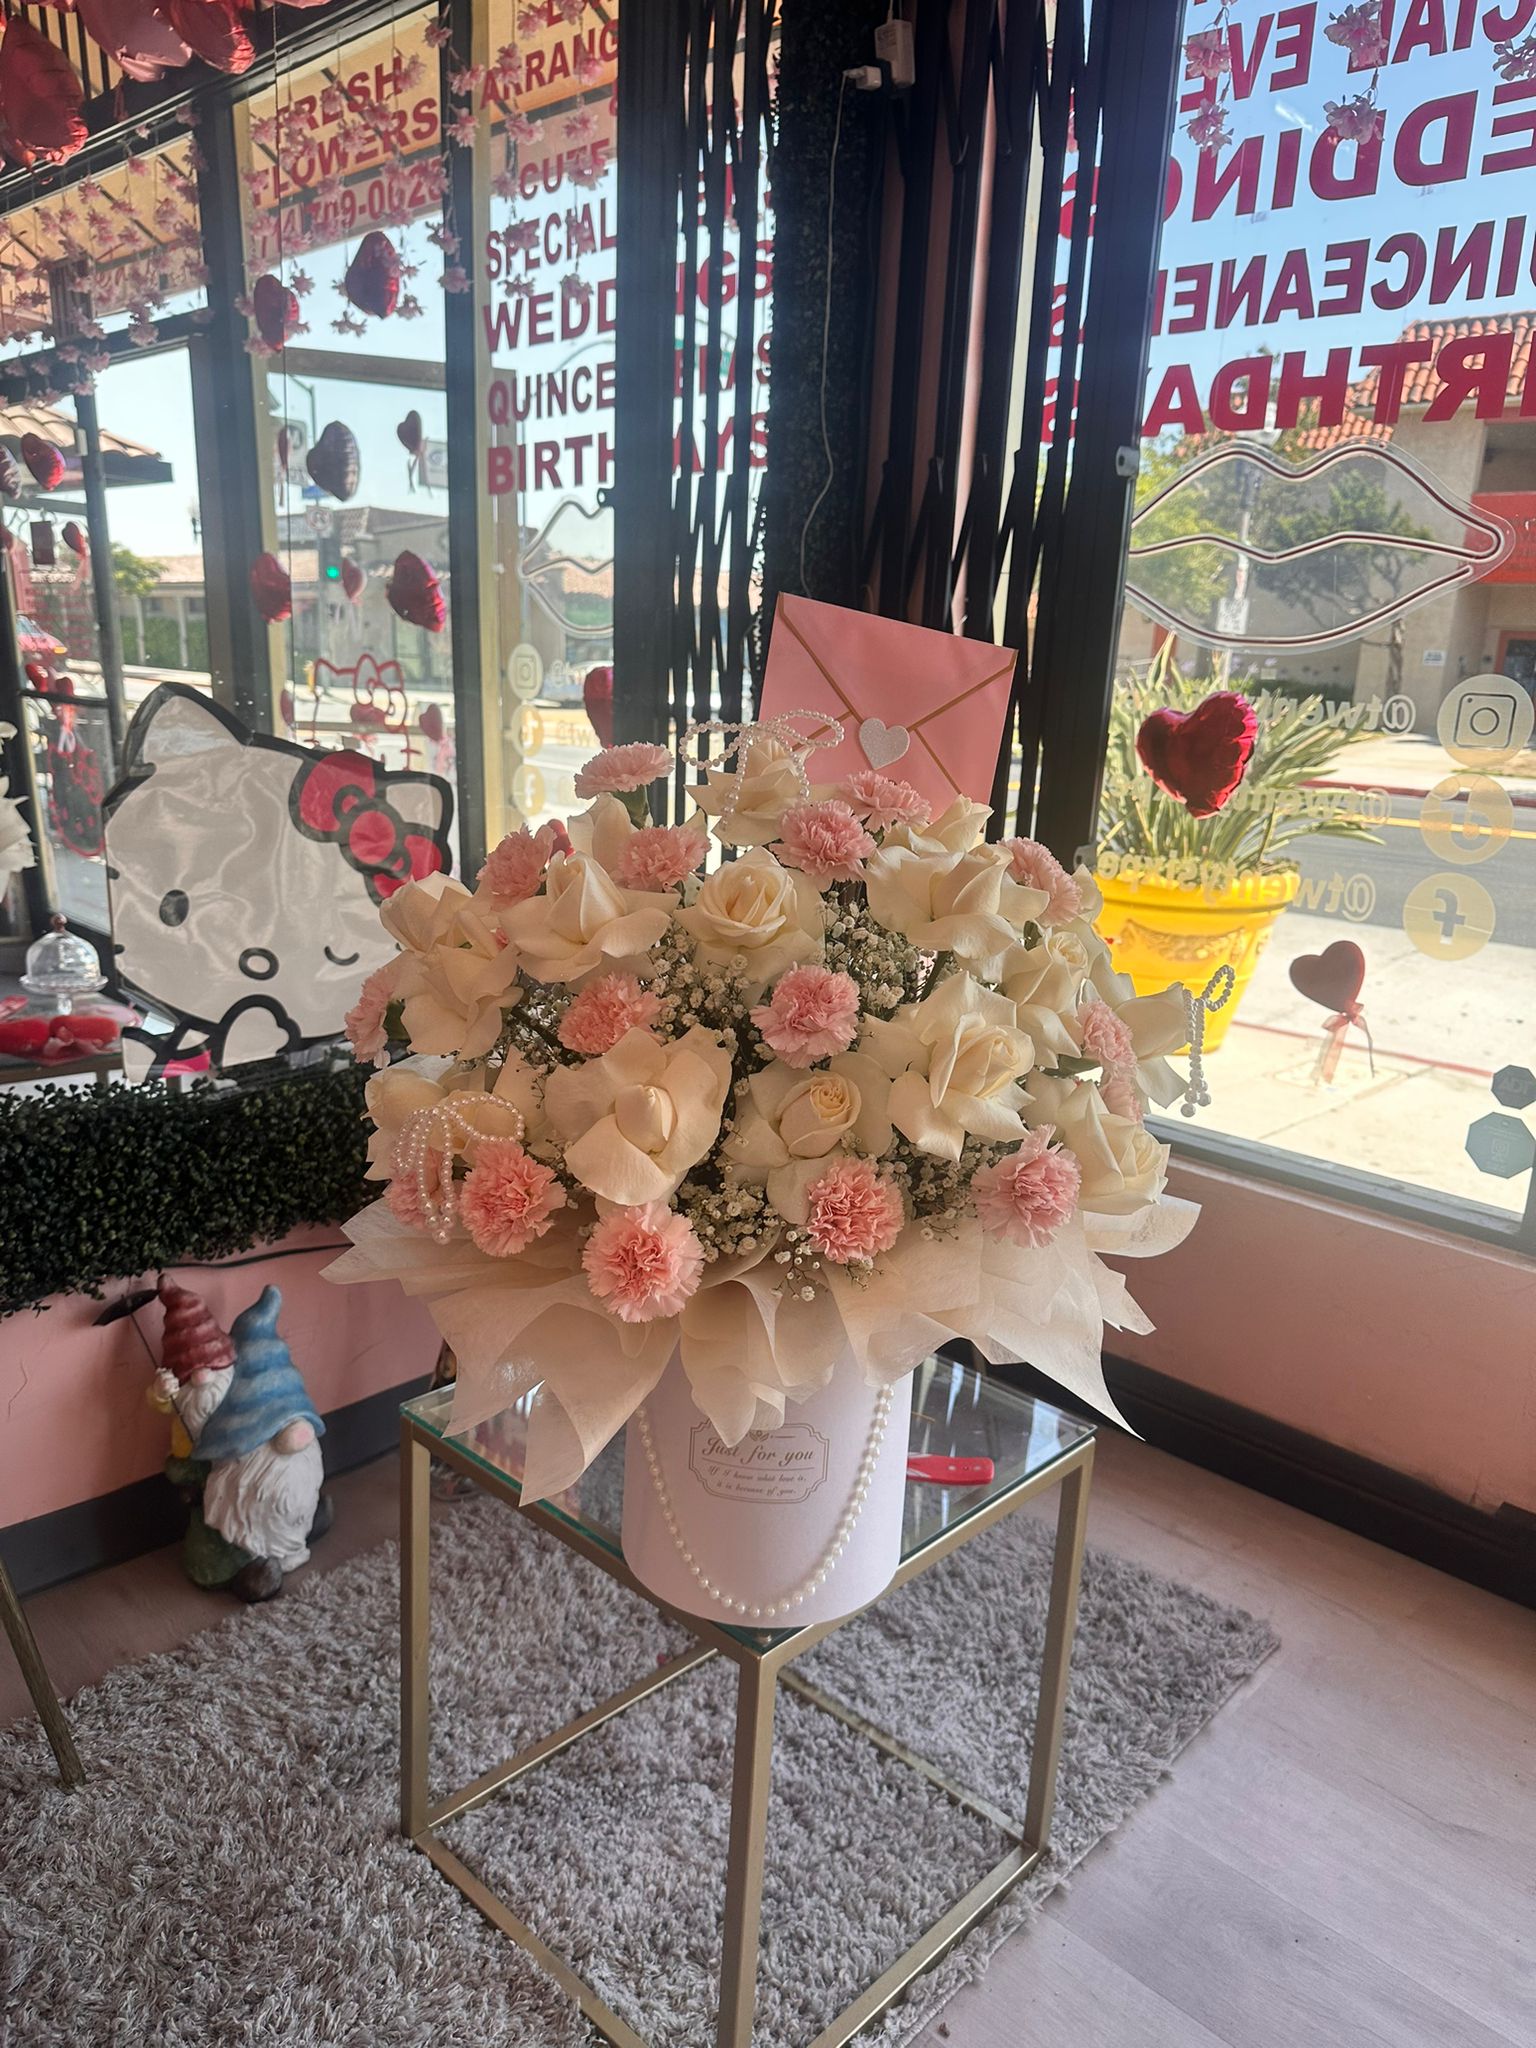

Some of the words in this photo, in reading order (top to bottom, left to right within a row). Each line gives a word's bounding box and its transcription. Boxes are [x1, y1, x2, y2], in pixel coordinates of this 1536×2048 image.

[702, 1437, 741, 1457] Just
[741, 1444, 776, 1465] for
[778, 1450, 815, 1467] you
